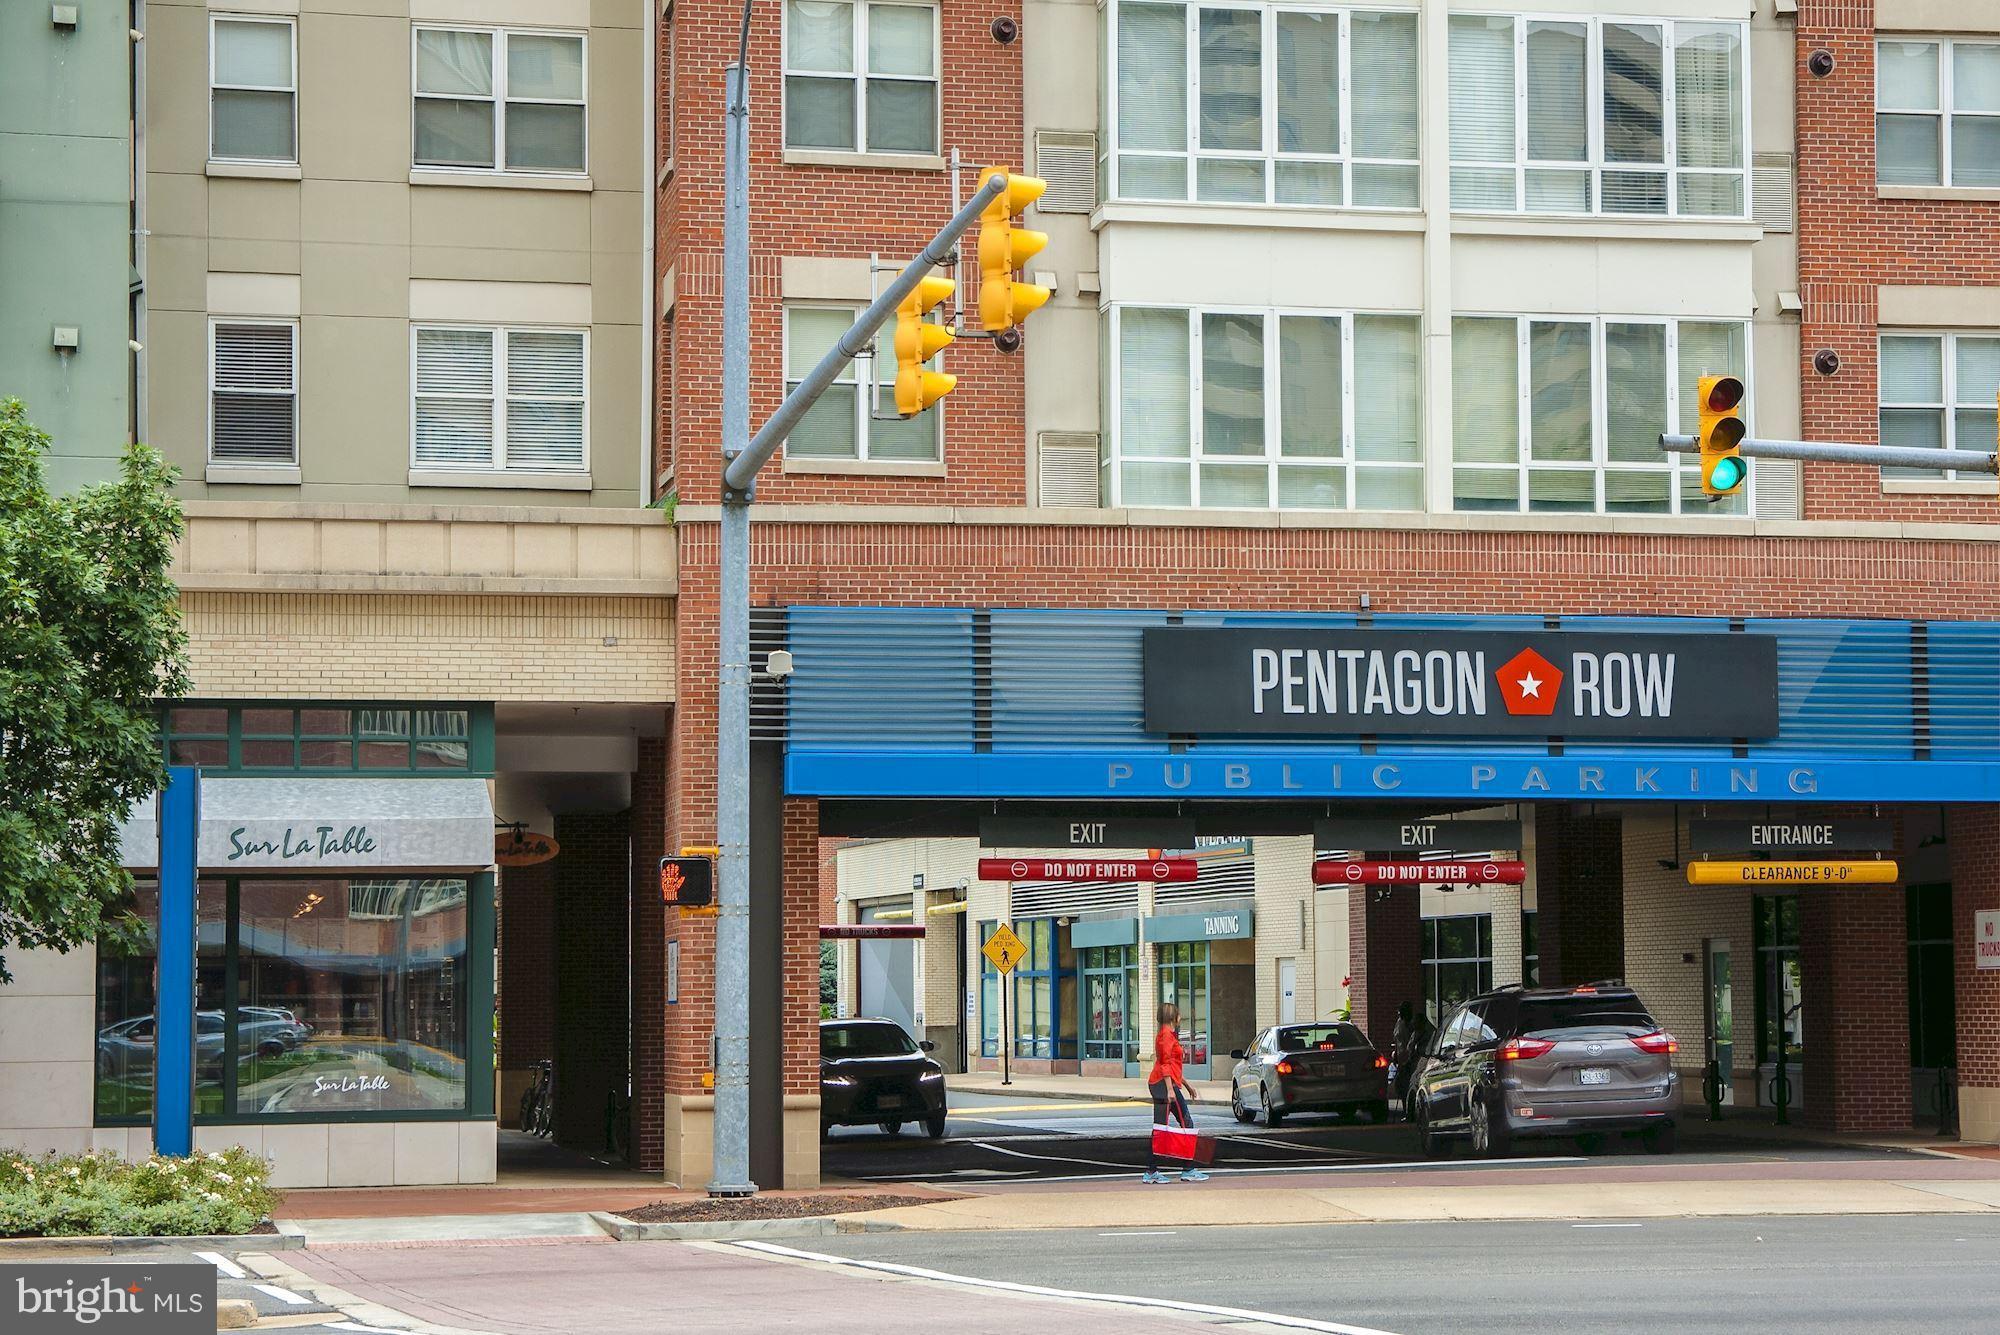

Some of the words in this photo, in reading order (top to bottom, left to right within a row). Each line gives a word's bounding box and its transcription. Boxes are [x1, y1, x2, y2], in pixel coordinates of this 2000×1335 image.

[1252, 648, 1487, 716] PENTAGON
[1572, 651, 1676, 718] ROW
[1107, 762, 1403, 791] PUBLIC
[1471, 763, 1819, 794] PARKING
[227, 827, 280, 861] Sur
[282, 828, 315, 859] La
[316, 825, 377, 859] Table
[1069, 823, 1107, 844] EXIT
[1401, 825, 1437, 846] EXIT
[1751, 825, 1834, 845] ENTRANCE
[1044, 863, 1062, 878] DO
[1066, 863, 1092, 878] NOT
[1095, 863, 1137, 878] ENTER
[1378, 865, 1396, 880] DO
[1399, 865, 1424, 880] NOT
[1427, 865, 1467, 880] ENTER
[1742, 866, 1819, 880] CLEARANCE
[1203, 915, 1240, 935] TANNING
[1984, 921, 1994, 937] NO
[312, 1075, 341, 1094] Sur
[341, 1076, 359, 1092] La
[359, 1074, 391, 1092] Table
